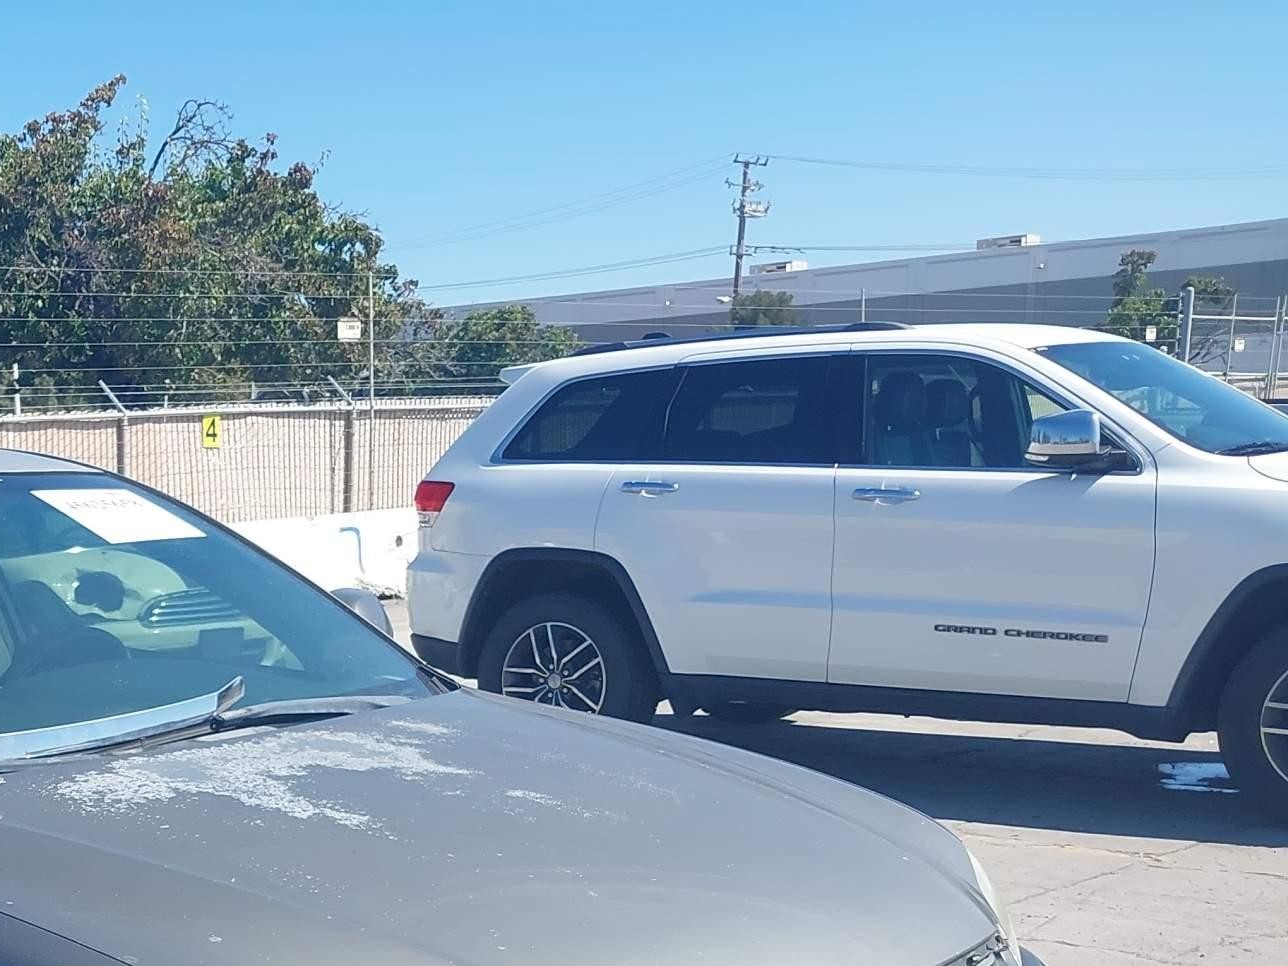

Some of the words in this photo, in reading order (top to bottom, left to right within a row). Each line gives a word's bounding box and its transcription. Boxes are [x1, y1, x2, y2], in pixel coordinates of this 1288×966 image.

[205, 417, 218, 443] 4
[934, 623, 998, 636] GRAND
[1003, 628, 1109, 643] CHEROKEE
